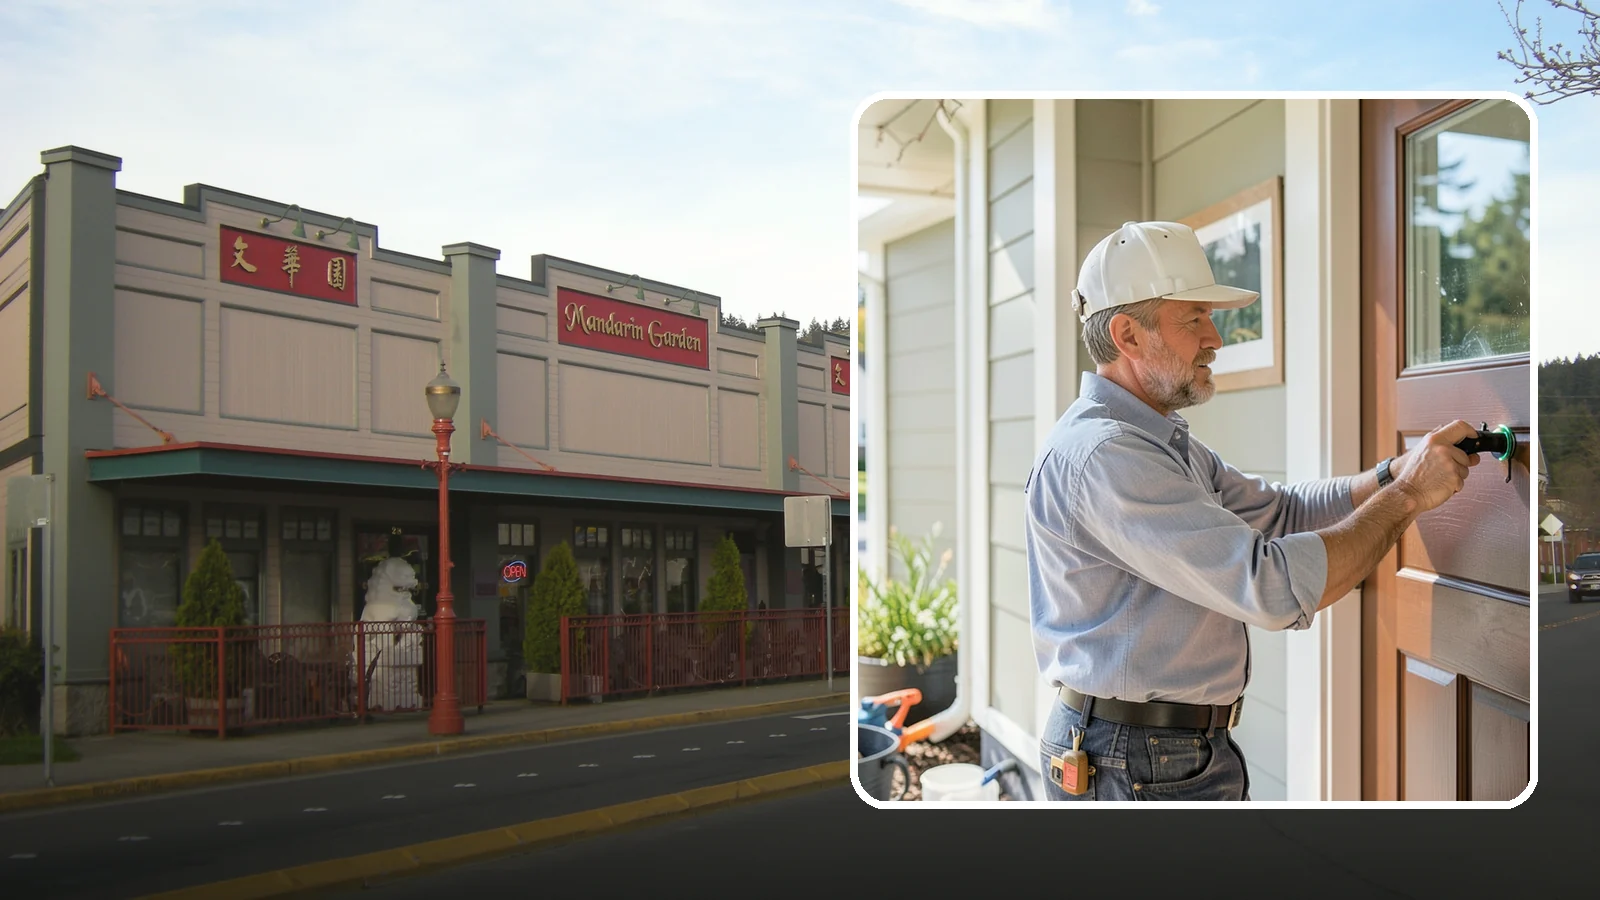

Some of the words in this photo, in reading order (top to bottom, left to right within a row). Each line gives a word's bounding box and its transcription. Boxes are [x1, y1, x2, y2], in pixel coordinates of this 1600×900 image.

[230, 235, 347, 290] 文華園
[564, 302, 644, 341] Mandarin
[648, 320, 701, 352] Garden
[503, 565, 527, 578] OPEN
